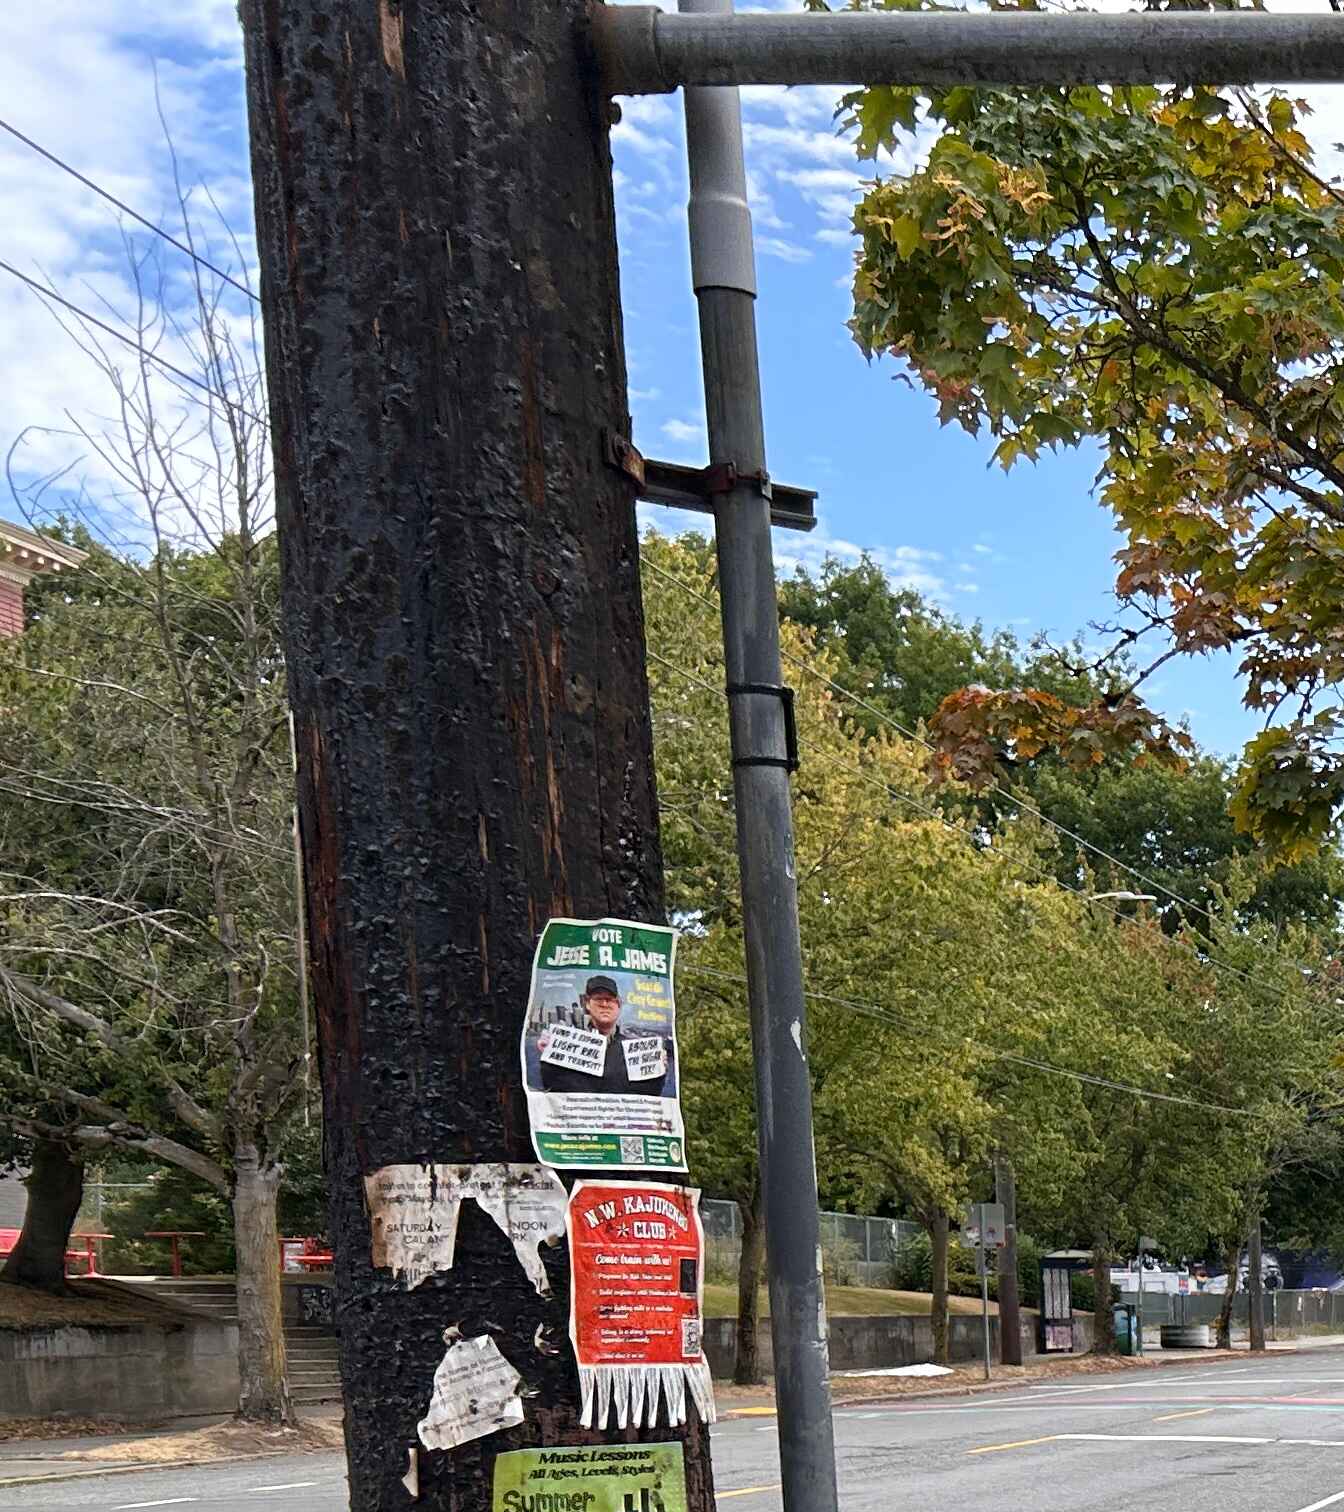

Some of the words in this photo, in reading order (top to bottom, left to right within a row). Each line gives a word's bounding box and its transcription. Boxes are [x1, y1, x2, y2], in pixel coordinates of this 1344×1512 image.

[592, 929, 622, 944] VOTE
[599, 946, 617, 967] A.
[622, 949, 667, 974] JAMES
[552, 1039, 580, 1053] LIGHT
[584, 1201, 624, 1229] N.W.
[386, 1223, 442, 1233] SATURDAY
[512, 1221, 548, 1231] NOON
[633, 1221, 667, 1239] CLUB
[595, 1254, 618, 1264] Come
[620, 1254, 642, 1264] train
[645, 1254, 661, 1264] with
[539, 1451, 589, 1464] Music
[590, 1450, 651, 1463] Lessons
[528, 1469, 545, 1480] All
